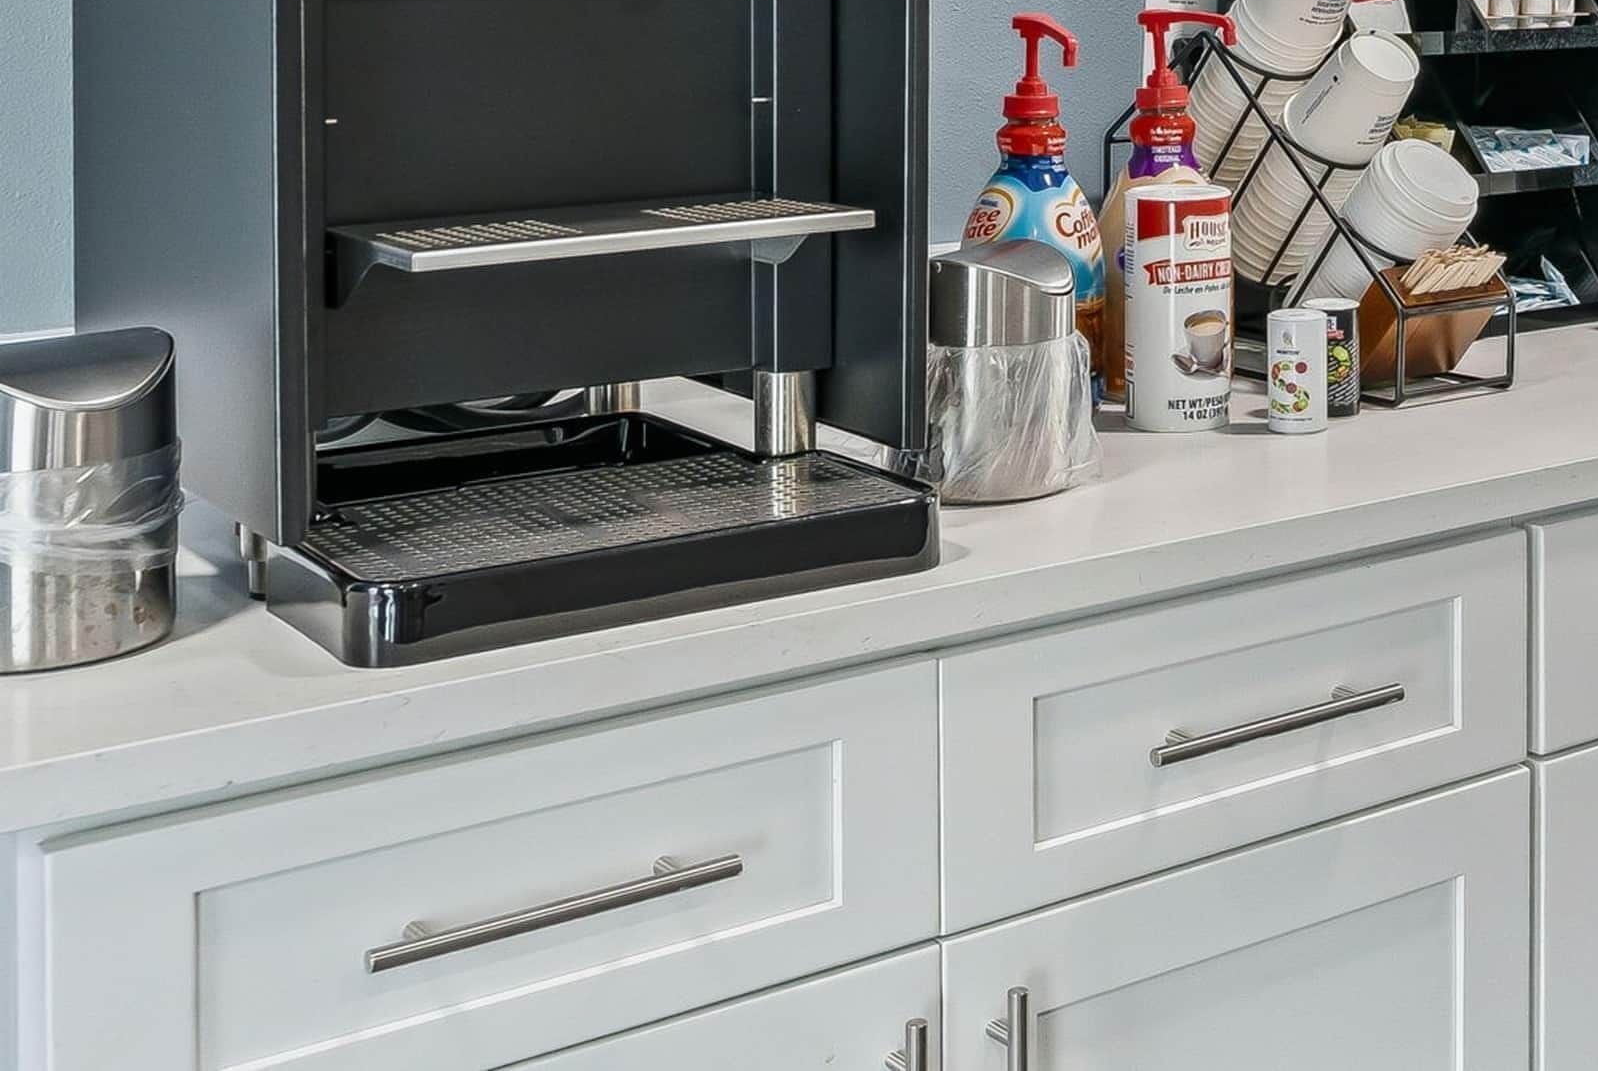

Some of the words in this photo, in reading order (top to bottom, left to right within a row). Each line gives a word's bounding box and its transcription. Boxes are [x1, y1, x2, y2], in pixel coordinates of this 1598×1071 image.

[1157, 262, 1215, 283] NON-DAIRY
[1168, 399, 1186, 410] NET
[1184, 410, 1195, 421] 14
[1196, 408, 1207, 420] OZ
